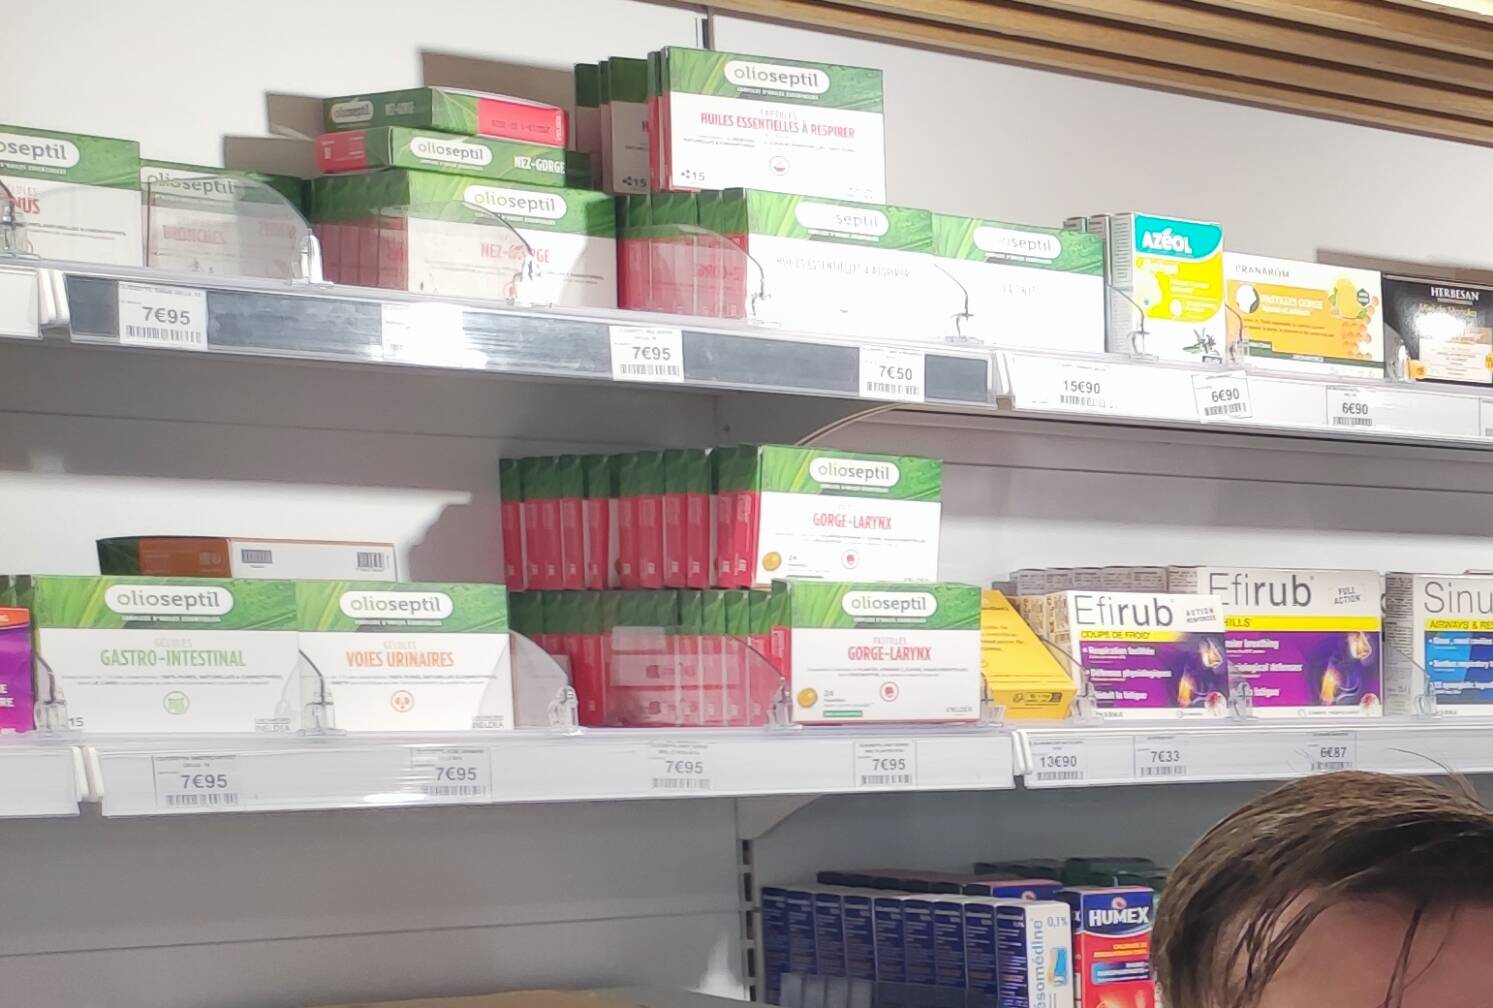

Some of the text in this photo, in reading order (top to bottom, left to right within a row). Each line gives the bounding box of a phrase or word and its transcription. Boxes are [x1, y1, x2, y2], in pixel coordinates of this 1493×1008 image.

[733, 64, 819, 88] olioseptil
[701, 111, 734, 127] HUILES
[736, 114, 799, 133] ESSENTIELLES
[811, 122, 855, 139] RESPIRER
[417, 141, 484, 162] olioseptil
[513, 155, 566, 175] NEZ-GORGE
[147, 171, 236, 196] olioseptil
[474, 190, 556, 213] olioseptil
[1430, 286, 1480, 301] HERBESAN
[141, 305, 191, 326] 7€95
[631, 345, 671, 361] 7€95
[879, 364, 913, 381] 7€50
[1062, 378, 1101, 395] 15€90
[1211, 387, 1241, 404] 6€90
[1341, 402, 1369, 417] 6€90
[818, 462, 890, 482] olioseptil
[812, 512, 893, 531] GORGE-LARYNX
[1208, 573, 1312, 607] Efirub
[117, 589, 221, 611] olioseptil
[350, 595, 442, 616] olioseptil
[850, 595, 927, 615] olioseptil
[1073, 594, 1175, 628] Efirub
[100, 649, 247, 667] GASTRO-INTESTINAL
[346, 650, 455, 669] VOIES URINAIRES
[848, 645, 932, 662] GORGE-LARYNX
[69, 716, 84, 728] 15
[1039, 754, 1078, 769] 13€90
[1150, 750, 1180, 763] 7€33
[1320, 747, 1347, 759] 6€87
[664, 760, 704, 776] 7€95
[872, 757, 907, 772] 7€95
[180, 773, 229, 790] 7€95
[434, 766, 478, 782] 7€95
[1088, 905, 1150, 928] HUMEX
